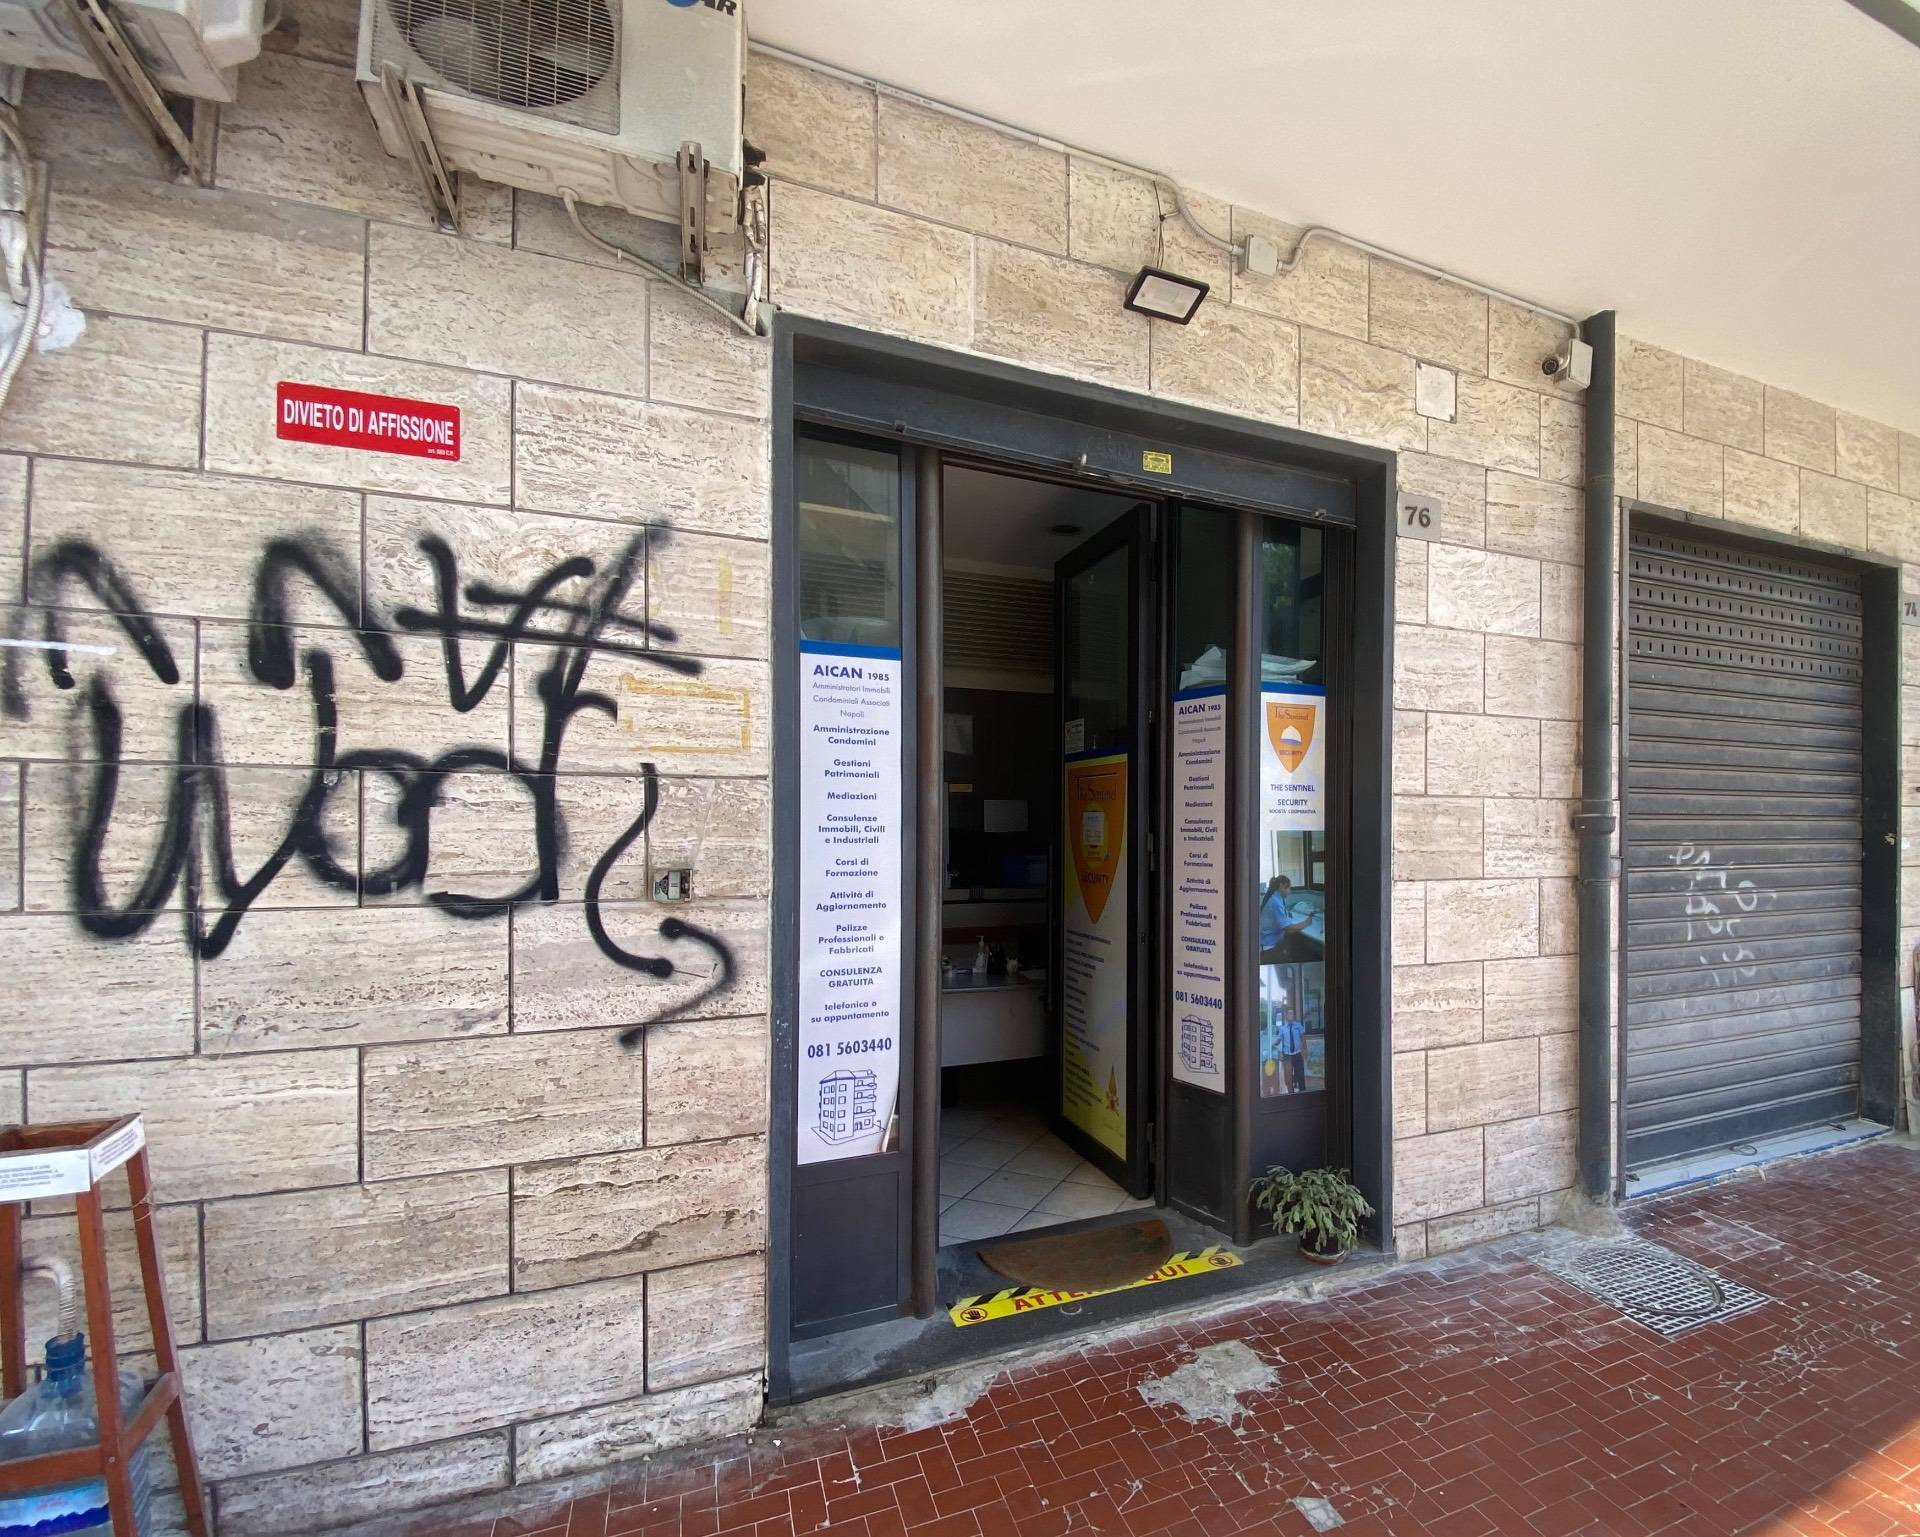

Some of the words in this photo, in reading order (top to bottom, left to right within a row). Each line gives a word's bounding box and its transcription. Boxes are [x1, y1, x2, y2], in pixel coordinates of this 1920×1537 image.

[284, 399, 344, 430] DIVIETO
[348, 408, 363, 433] DI
[368, 411, 453, 445] AFFISSIONE
[1405, 506, 1430, 528] 76
[813, 664, 863, 679] AICAN
[868, 672, 889, 681] 1985
[840, 710, 864, 719] Napoli
[1179, 704, 1205, 715] AICAN
[813, 725, 889, 736] Amministrazione
[828, 736, 876, 746] Condomini
[834, 759, 871, 767] Gestioni
[825, 770, 880, 779] Patrimoniali
[827, 792, 877, 800] Mediazioni
[827, 814, 877, 822] Consulenze
[818, 825, 862, 833] Immobili,
[825, 869, 878, 877] Formazione
[866, 890, 874, 898] di
[816, 902, 887, 912] Aggiornamento
[836, 924, 868, 932] Polizze
[818, 934, 877, 944] Professionali
[829, 945, 874, 954] Fabbricati
[820, 967, 882, 977] CONSULENZA
[829, 978, 874, 987] GRATUITA
[1176, 991, 1187, 1001] 081
[1191, 994, 1222, 1009] 5603440
[825, 1001, 869, 1011] telefonica
[824, 1010, 889, 1023] appuntamento
[808, 1044, 831, 1058] 081
[837, 1038, 891, 1056] 5603440
